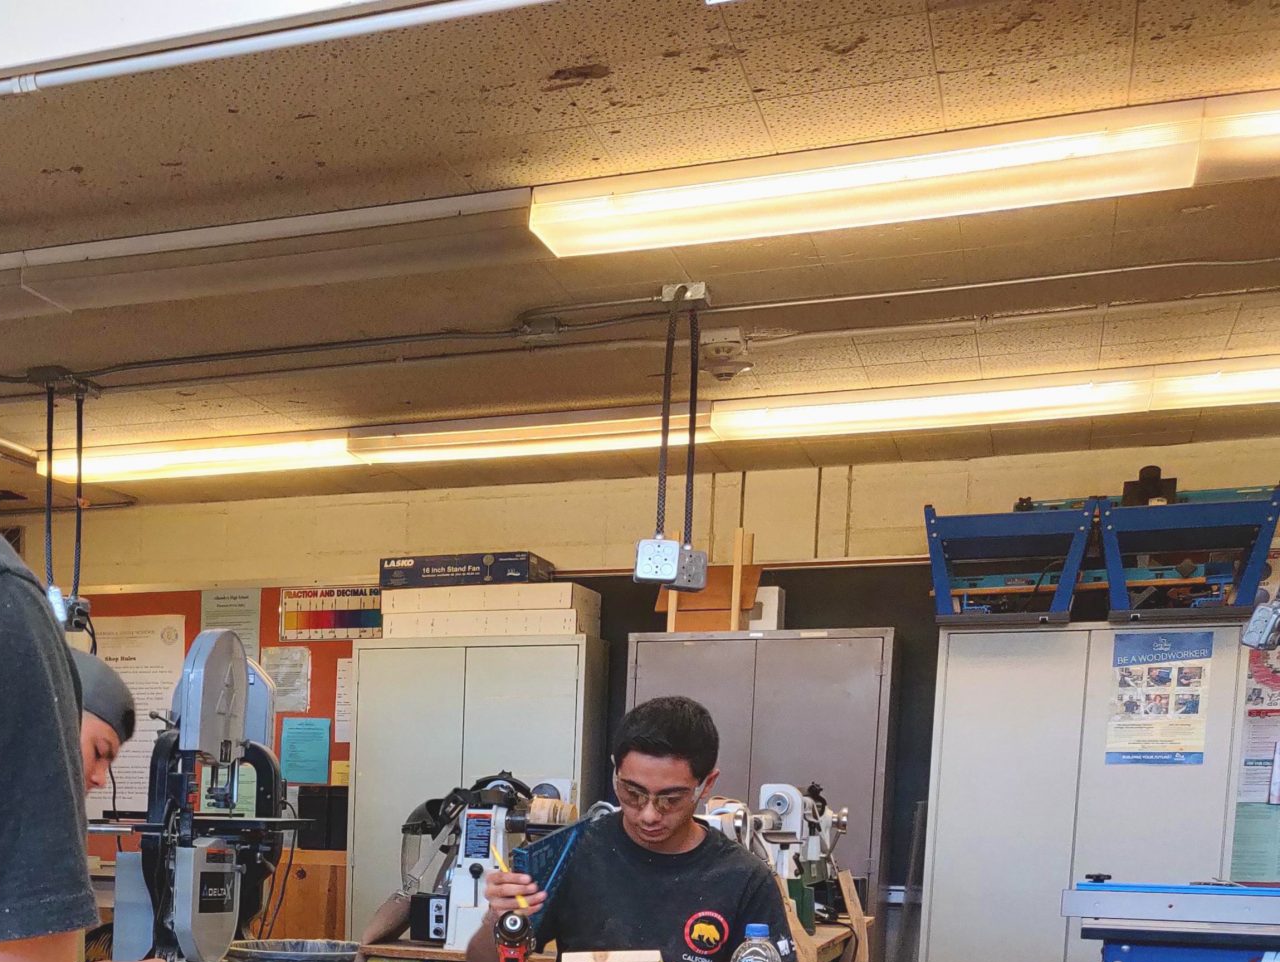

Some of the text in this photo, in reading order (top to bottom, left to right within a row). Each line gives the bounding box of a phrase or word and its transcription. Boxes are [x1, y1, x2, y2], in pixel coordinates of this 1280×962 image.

[383, 558, 416, 568] LASKO
[446, 565, 467, 573] Stand
[320, 589, 336, 598] AND
[336, 588, 367, 597] DECIMAL
[368, 588, 380, 596] EQ
[1117, 648, 1208, 665] BE A WOODWORKER!
[208, 887, 226, 897] DELTA
